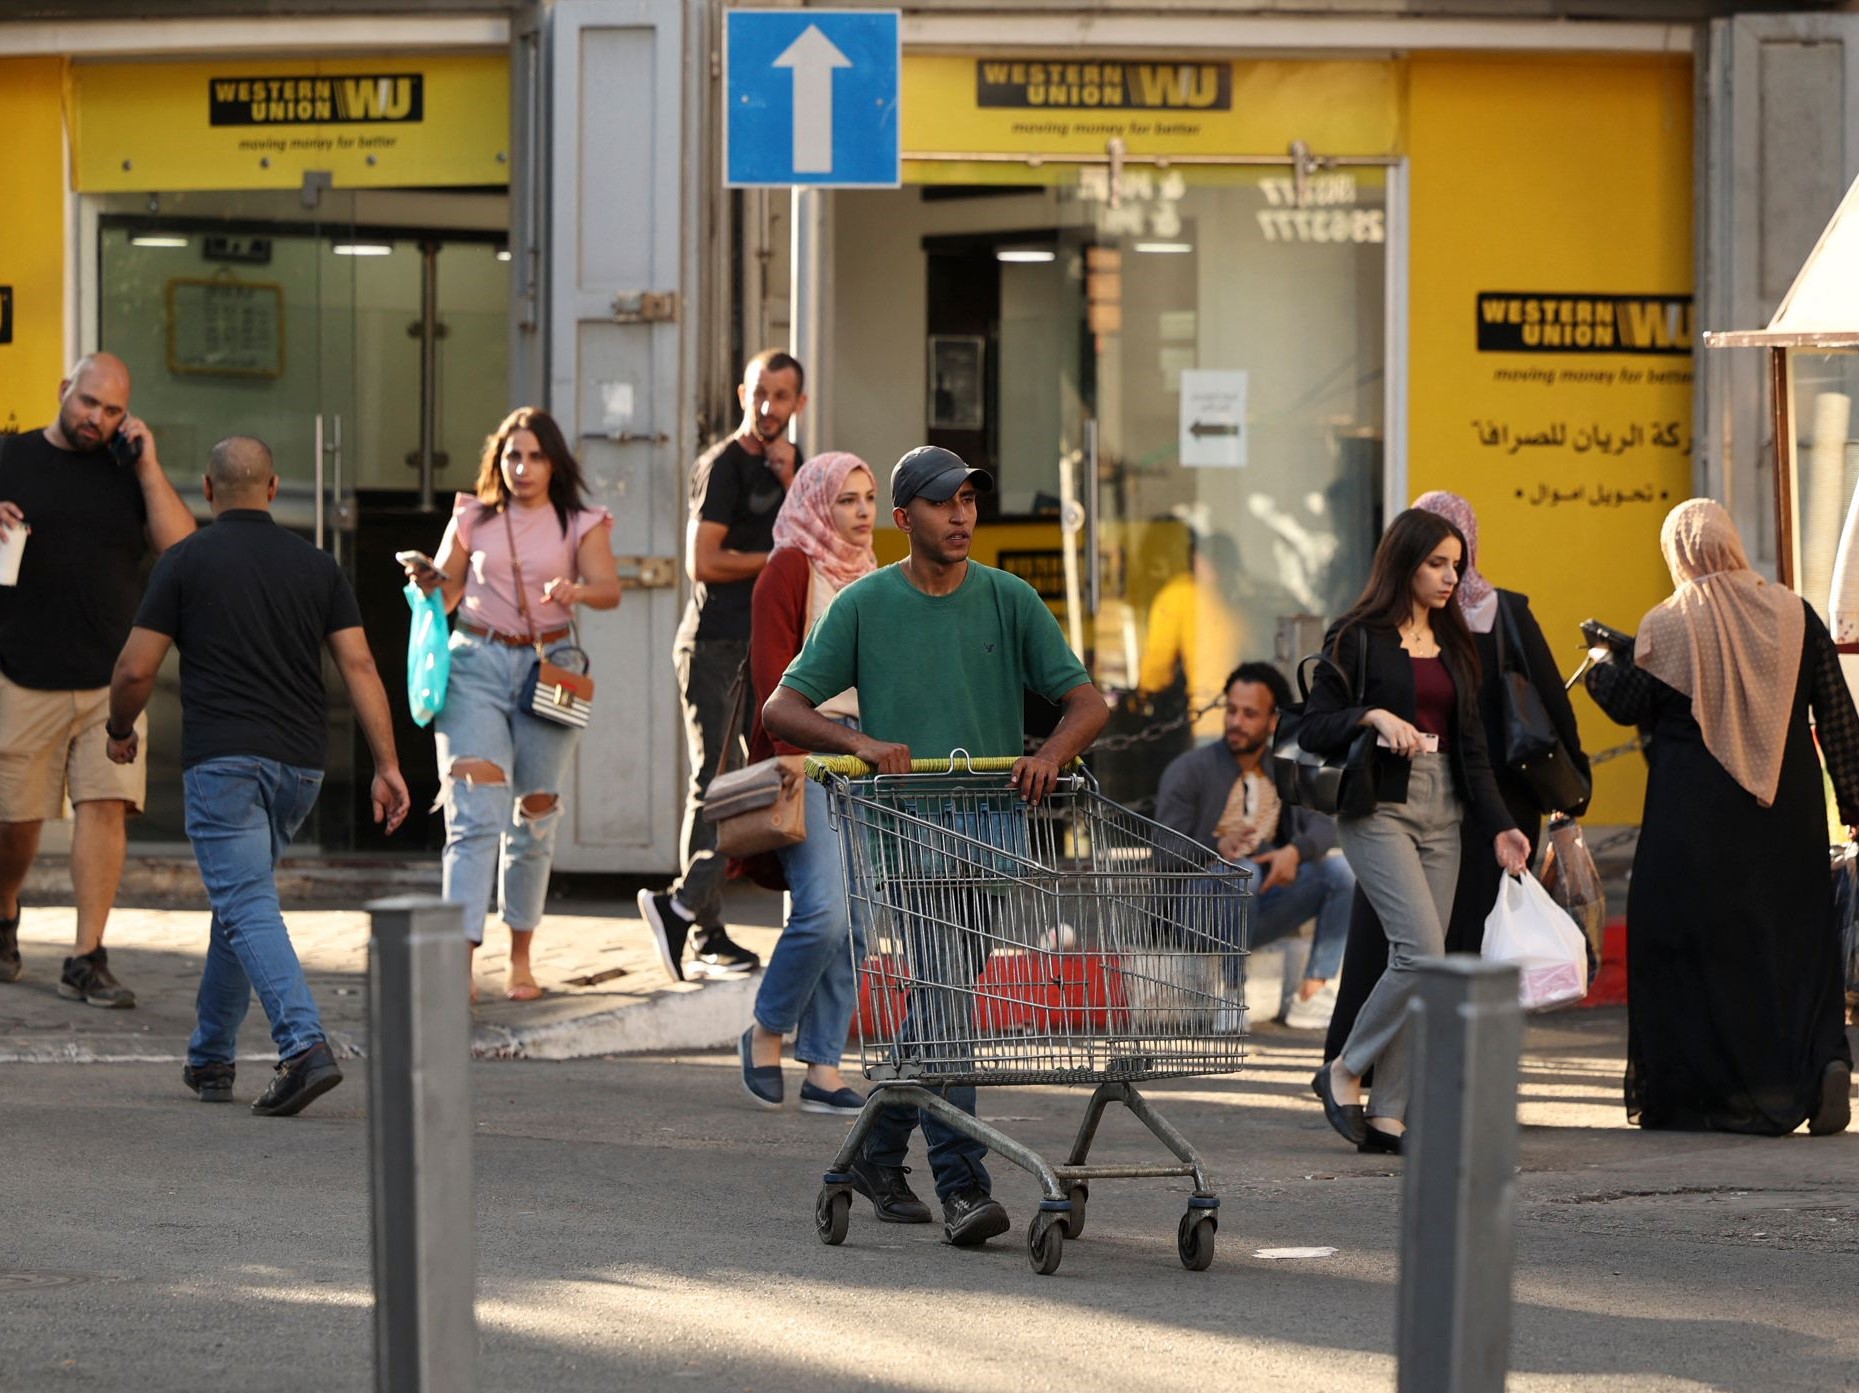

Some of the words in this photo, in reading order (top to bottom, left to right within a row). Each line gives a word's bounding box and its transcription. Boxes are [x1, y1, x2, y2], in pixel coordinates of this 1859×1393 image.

[983, 63, 1123, 85] WESTERN
[1140, 64, 1218, 107] WU
[1026, 85, 1123, 106] UNION
[215, 79, 331, 102] WESTERN
[345, 78, 412, 120] WU
[251, 101, 331, 121] UNION
[1012, 122, 1069, 136] moving
[1074, 123, 1124, 136] money
[1129, 120, 1151, 134] for
[1154, 120, 1200, 134] better
[239, 137, 287, 152] moving
[291, 137, 333, 151] money
[337, 136, 355, 149] for
[358, 135, 396, 149] better
[1482, 299, 1614, 324] WESTERN
[1521, 323, 1614, 346] UNION
[1493, 368, 1555, 384] moving
[1561, 369, 1615, 384] money
[1619, 366, 1642, 382] for
[1573, 423, 1645, 454] الريان
[1652, 421, 1694, 456] ركة
[1588, 484, 1653, 507] تحويل
